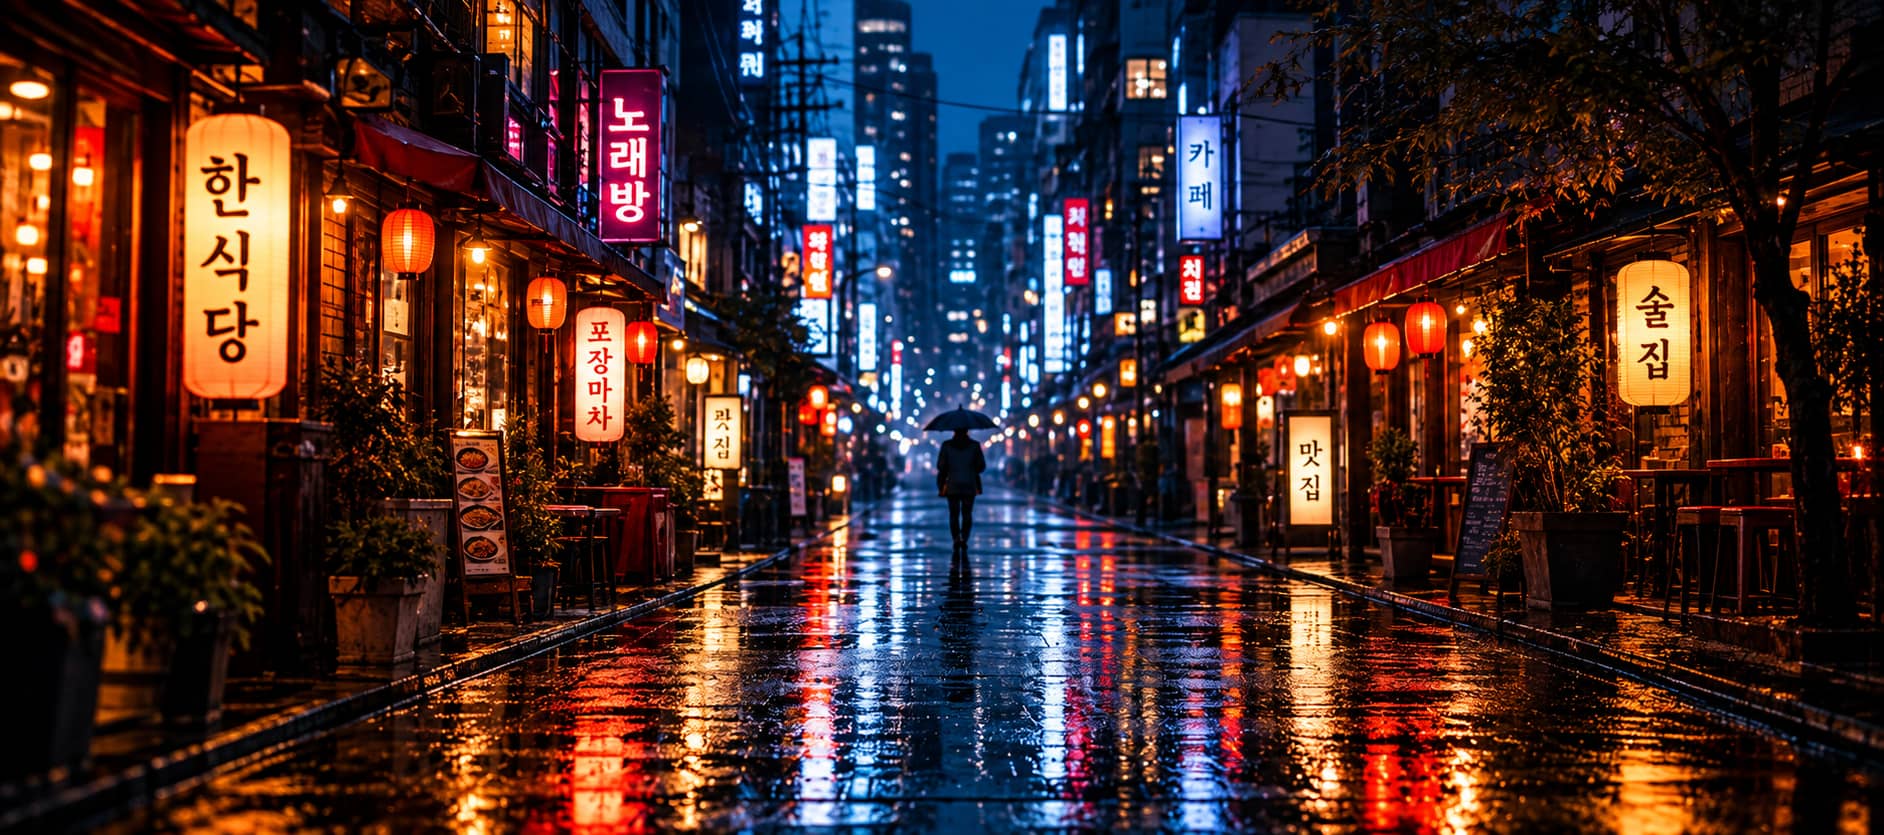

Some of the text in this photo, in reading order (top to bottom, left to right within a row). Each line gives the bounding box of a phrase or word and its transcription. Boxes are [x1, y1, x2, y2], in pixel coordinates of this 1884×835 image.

[608, 97, 650, 223] 노래방
[1189, 139, 1214, 210] 카페
[200, 153, 260, 363] 한식당
[587, 321, 613, 431] 포장마차
[1635, 285, 1675, 380] 술집
[1299, 440, 1323, 502] 맛집
